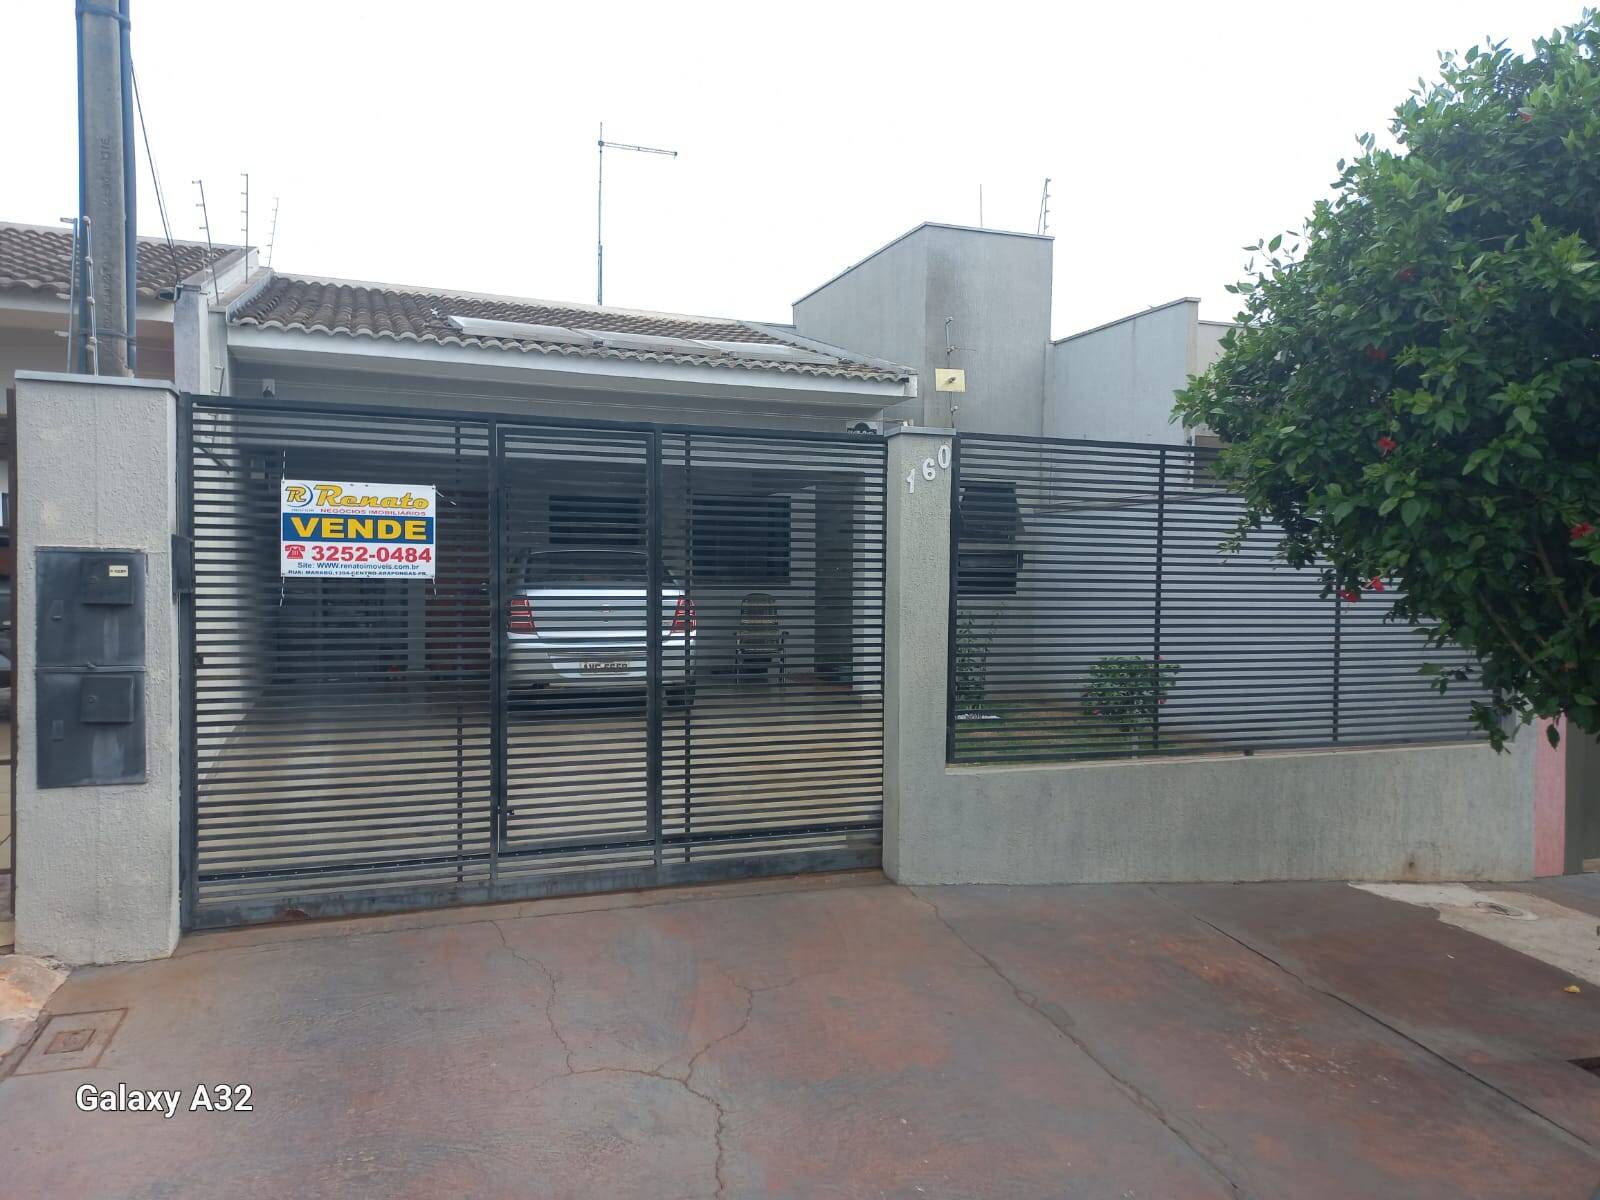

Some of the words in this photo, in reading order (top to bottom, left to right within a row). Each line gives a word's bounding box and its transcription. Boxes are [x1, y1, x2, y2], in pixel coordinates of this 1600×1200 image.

[906, 444, 951, 495] 160
[313, 484, 430, 510] Renato
[291, 516, 427, 540] VENDE
[297, 561, 315, 569] Site:
[317, 562, 419, 570] WWW.renatoimoveis.com.br
[311, 545, 432, 563] 3252-0484
